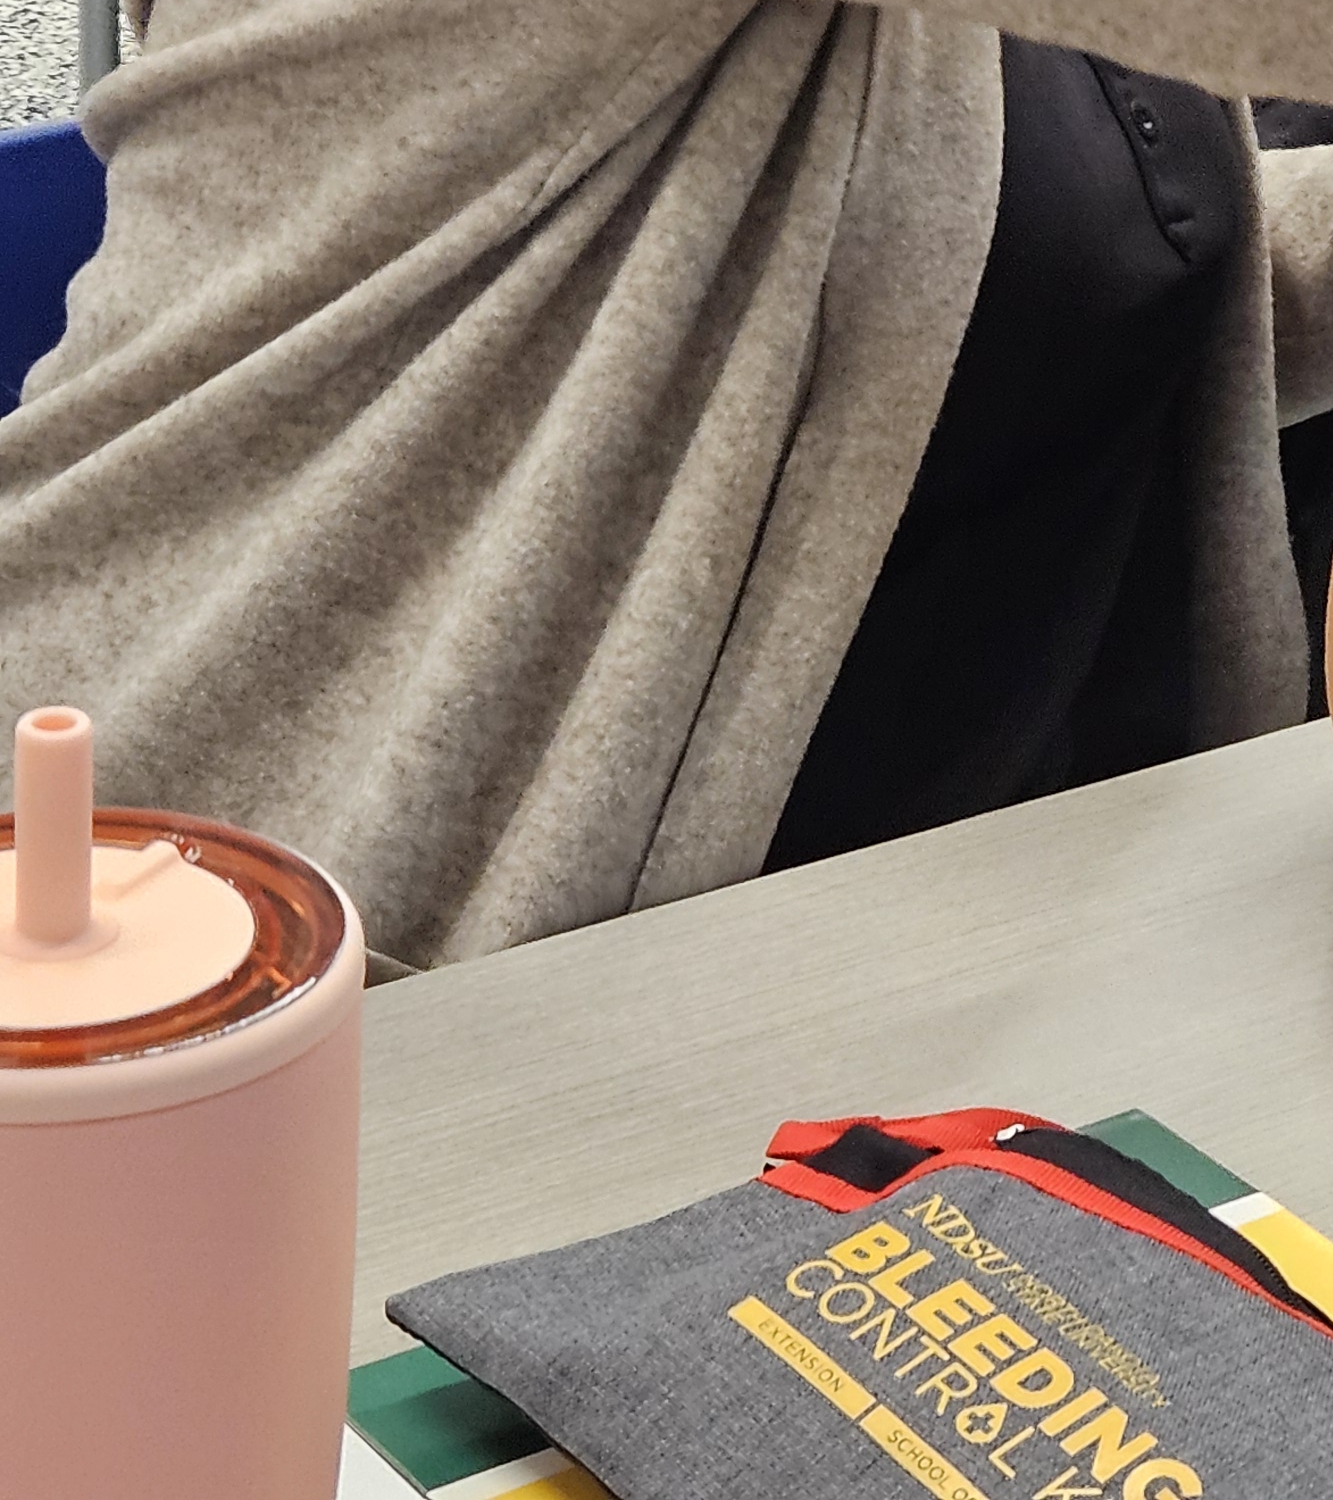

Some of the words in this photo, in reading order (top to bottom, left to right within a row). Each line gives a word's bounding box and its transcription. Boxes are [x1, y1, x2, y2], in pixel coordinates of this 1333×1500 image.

[902, 1192, 1025, 1276] NDSU
[757, 1316, 846, 1394] EXTENSION
[887, 1429, 950, 1491] SCHOOL
